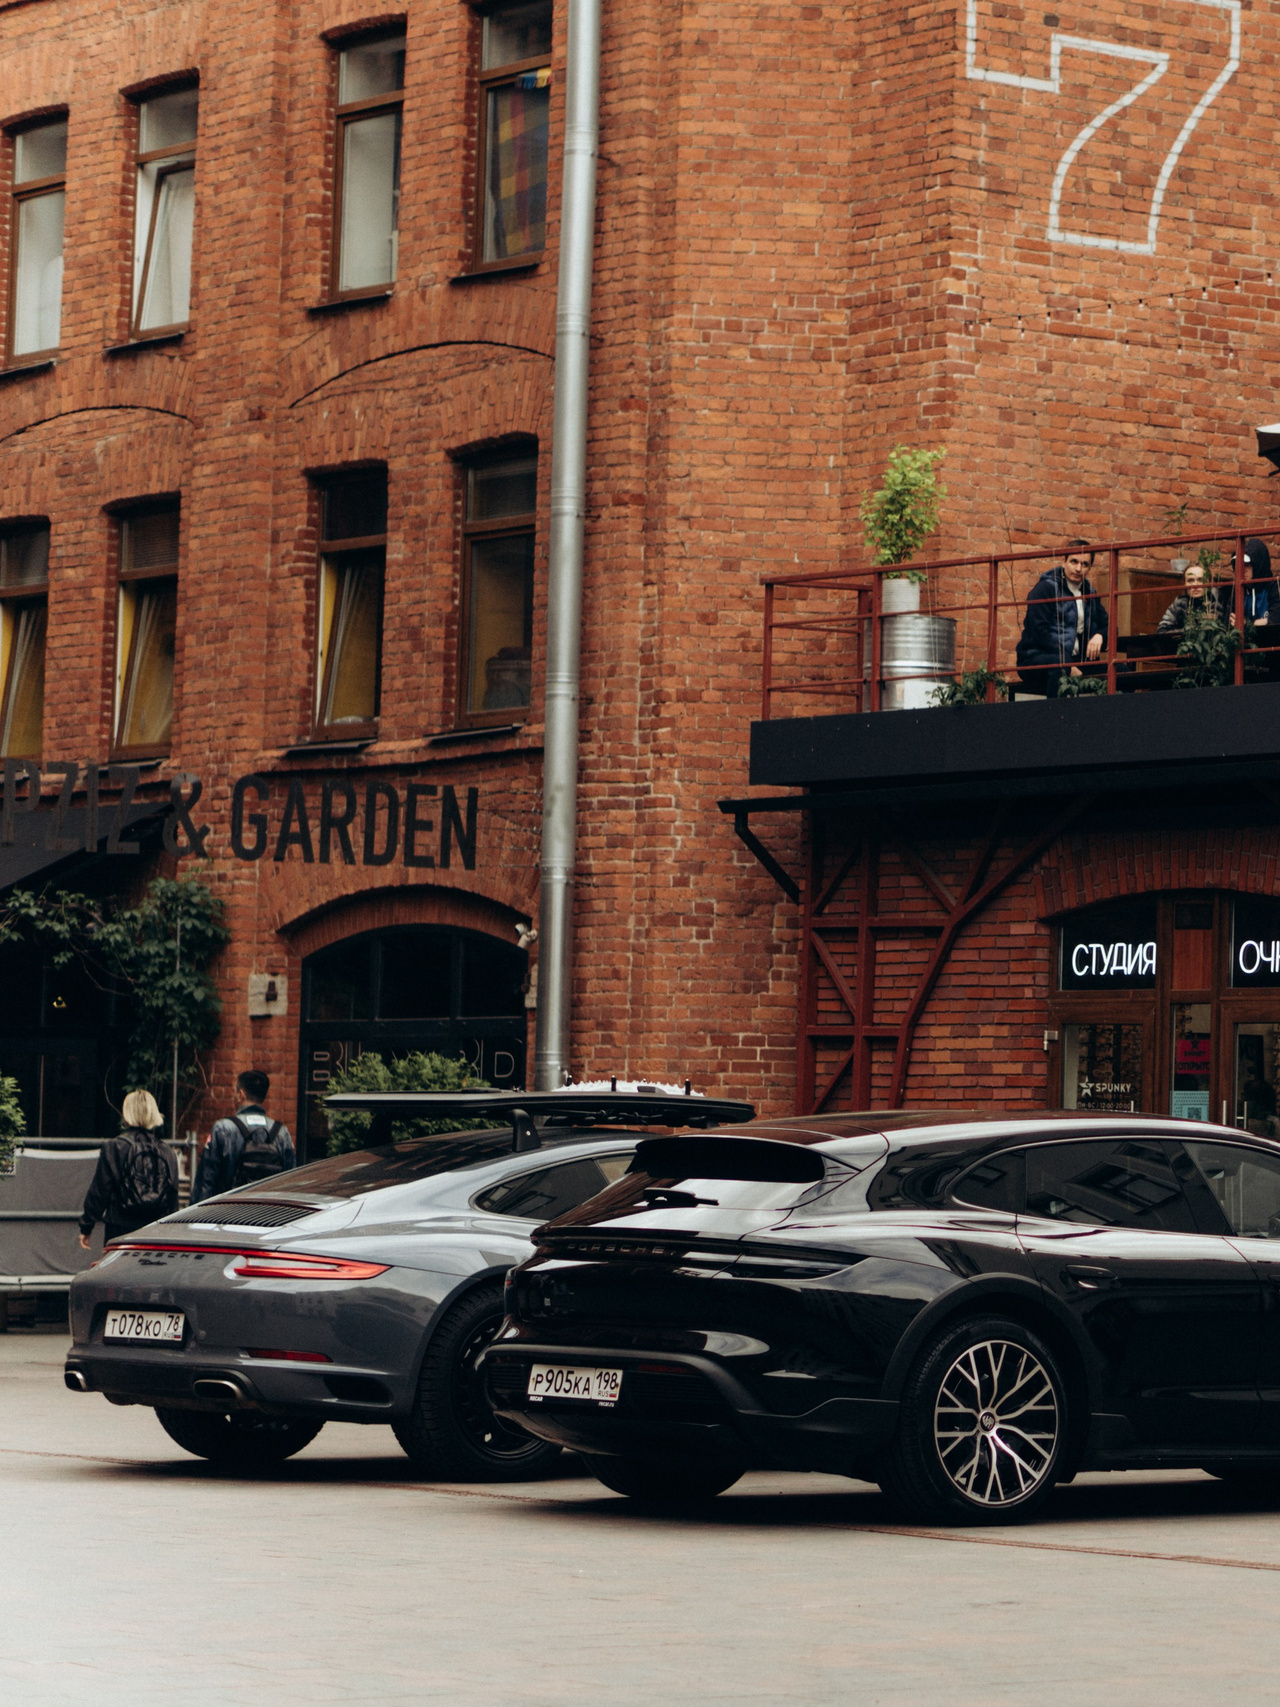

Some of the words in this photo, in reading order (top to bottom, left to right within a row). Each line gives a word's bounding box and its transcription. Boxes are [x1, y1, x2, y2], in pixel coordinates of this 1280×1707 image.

[966, 0, 1242, 255] 7
[230, 773, 479, 872] GARDEN
[1072, 942, 1157, 977] СТУДИЯ
[1095, 1083, 1132, 1093] SPUNKY
[167, 1315, 180, 1332] 78
[596, 1371, 618, 1390] 198
